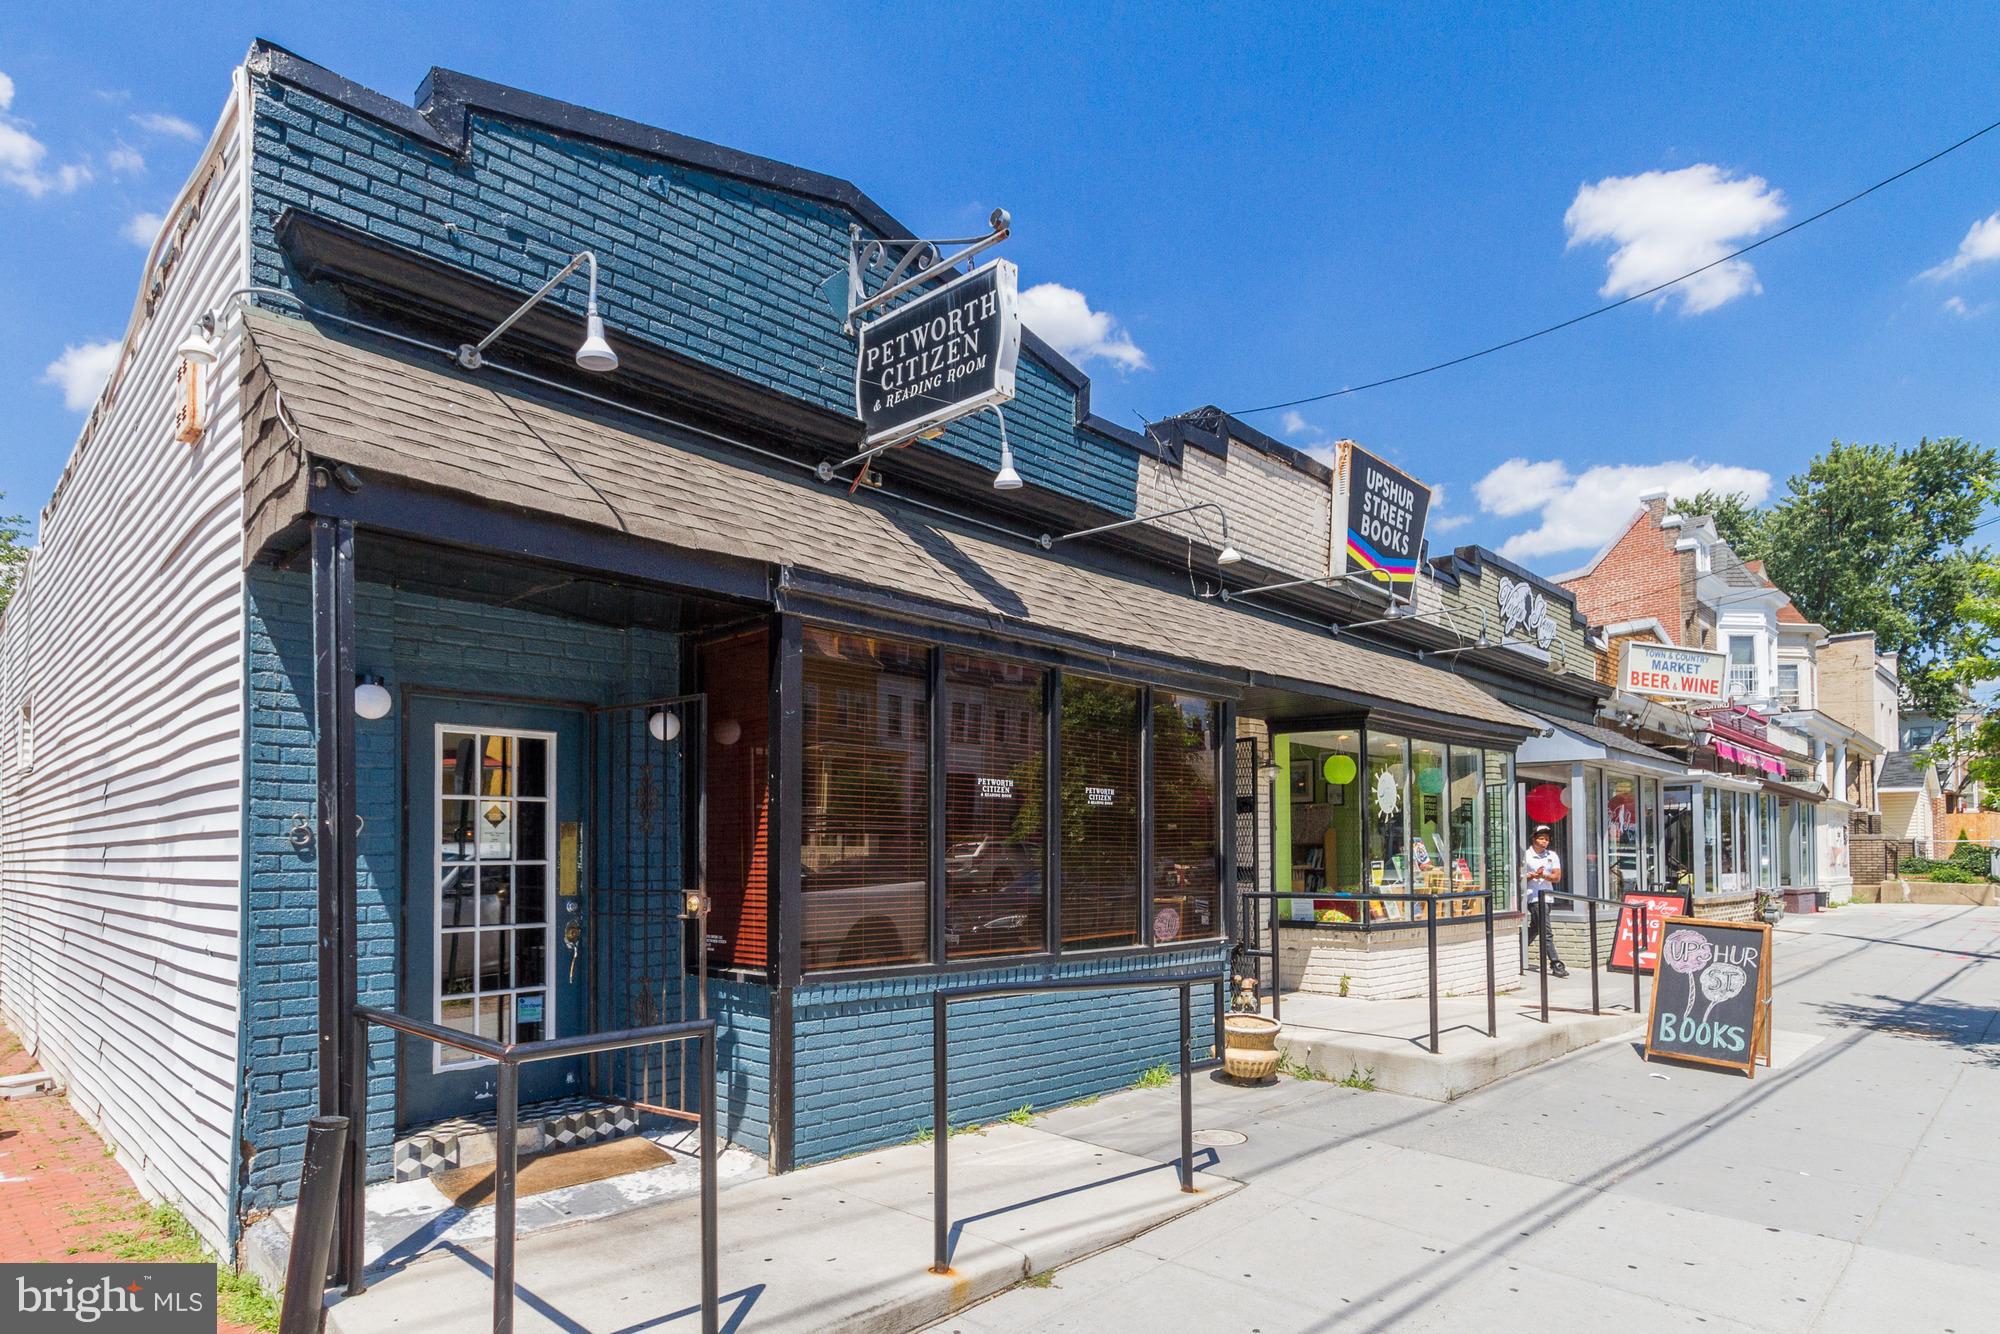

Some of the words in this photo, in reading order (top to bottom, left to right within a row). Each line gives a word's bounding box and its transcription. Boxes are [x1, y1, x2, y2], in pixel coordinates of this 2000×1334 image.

[866, 289, 997, 372] PETWORTH
[880, 328, 980, 391] CITIZEN
[873, 399, 882, 412] &
[885, 373, 942, 408] READING
[946, 354, 987, 383] ROOM
[1366, 467, 1415, 512] UPSHUR
[1363, 491, 1413, 533] STREET
[1360, 513, 1410, 556] BOOKS
[1644, 648, 1666, 659] TOWN
[1675, 652, 1710, 664] COUNTRY
[1651, 660, 1701, 675] MARKET
[1630, 671, 1670, 690] BEER
[1681, 676, 1720, 695] WINE
[977, 778, 1014, 787] PETWORTH
[982, 785, 1010, 793] CITIZEN
[1085, 787, 1115, 796] PETWORTH
[1670, 941, 1759, 968] UPSHUR
[1708, 969, 1739, 992] ST
[1659, 1012, 1746, 1051] BOOKS
